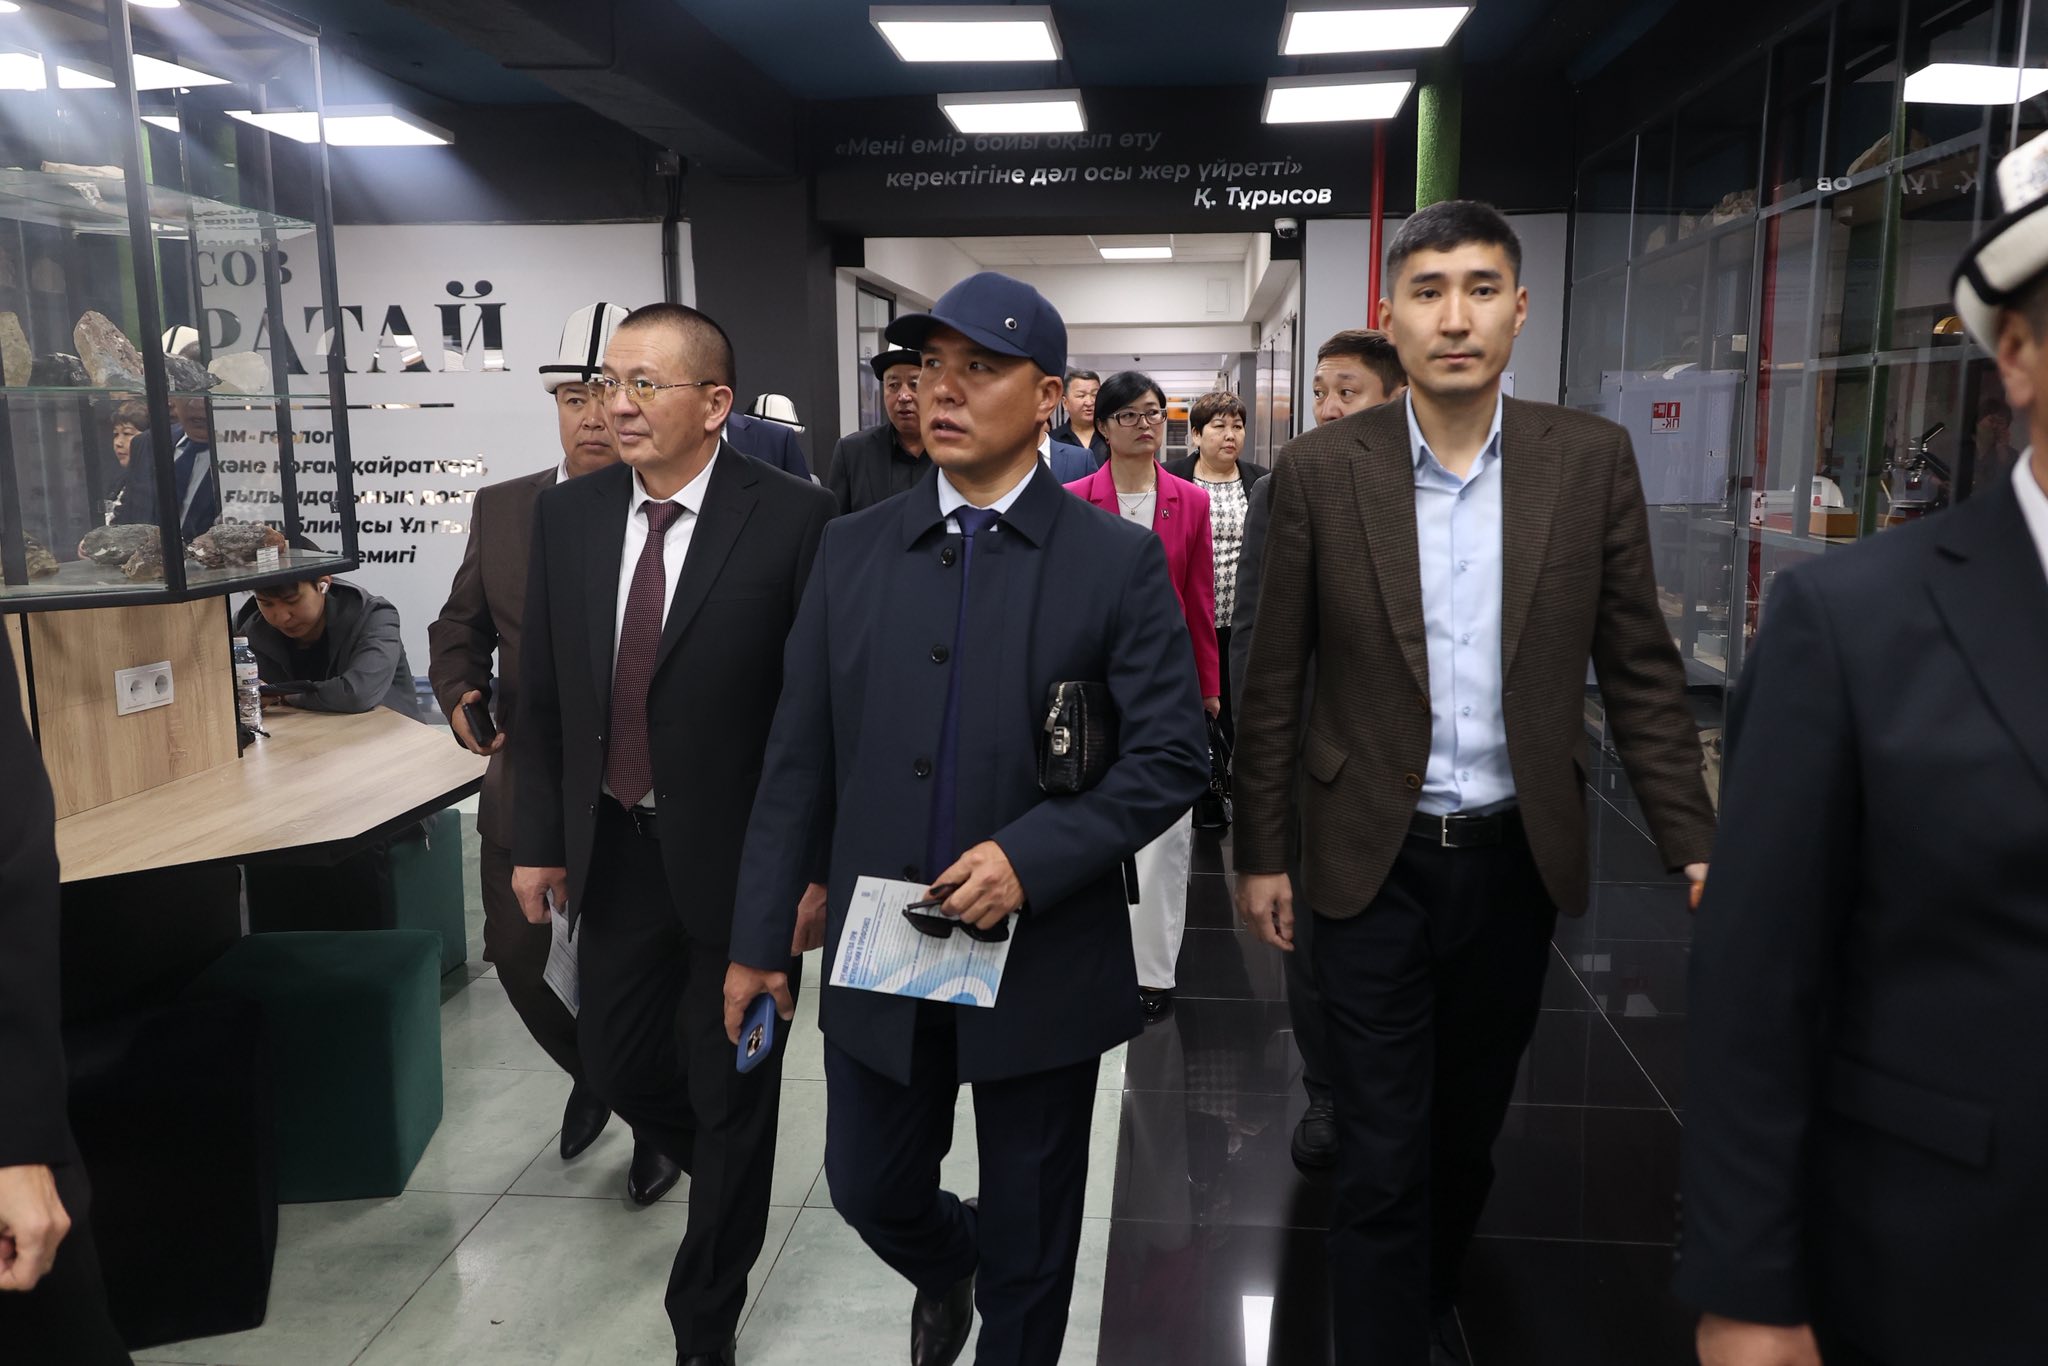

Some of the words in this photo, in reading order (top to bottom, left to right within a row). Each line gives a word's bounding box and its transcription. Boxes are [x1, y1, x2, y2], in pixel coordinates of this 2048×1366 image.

[834, 134, 906, 156] «Мені
[911, 133, 968, 157] өмір
[1046, 133, 1112, 151] оқып
[1119, 131, 1163, 152] өту
[885, 163, 1026, 191] керектігіне
[1029, 167, 1078, 187] дәл
[1084, 165, 1133, 182] осы
[1139, 162, 1191, 183] жер
[1198, 155, 1304, 183] үйретті»
[1193, 187, 1217, 210] Қ.
[1225, 186, 1333, 211] Тұрысов
